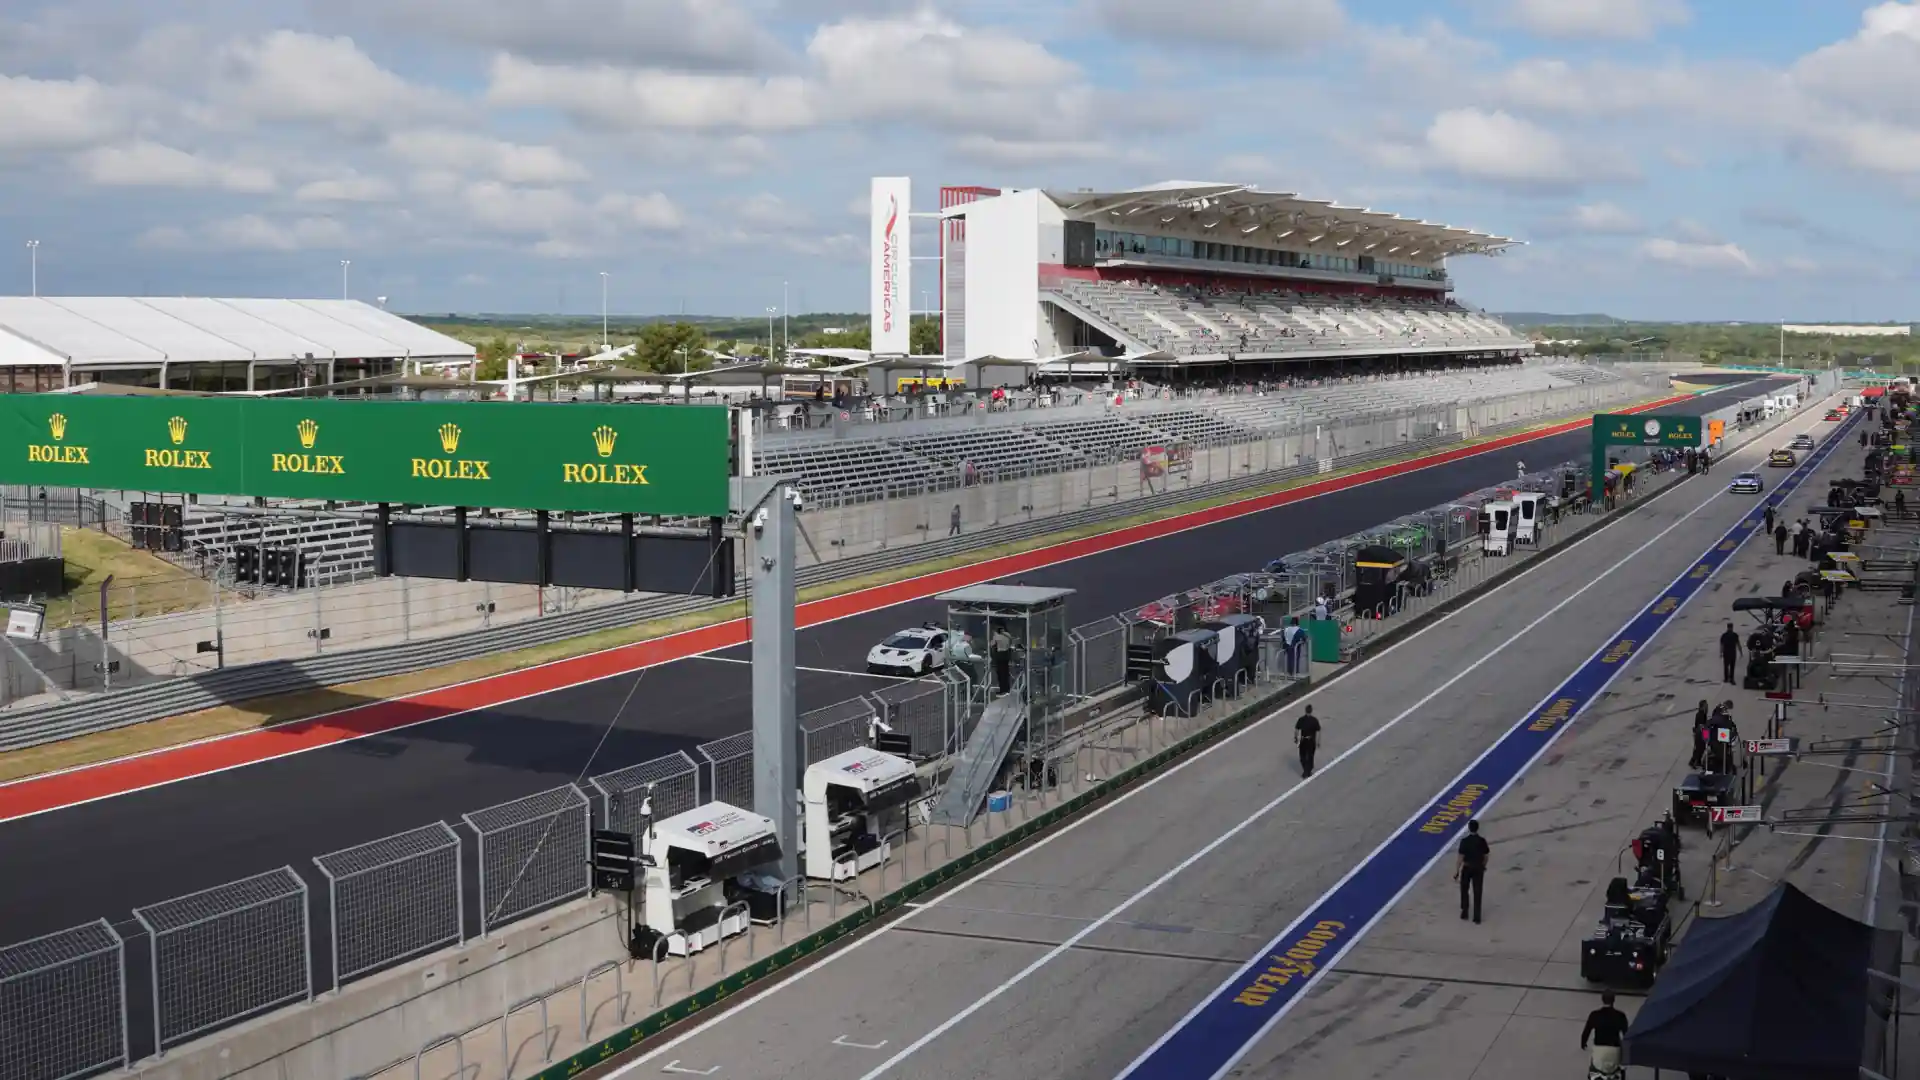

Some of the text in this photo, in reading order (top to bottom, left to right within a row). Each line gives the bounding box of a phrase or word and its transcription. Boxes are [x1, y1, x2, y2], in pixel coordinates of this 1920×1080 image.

[884, 242, 892, 332] AMERICAS
[28, 444, 90, 464] ROLEX
[144, 449, 212, 469] ROLEX
[271, 454, 346, 475] ROLEX
[411, 459, 491, 480] ROLEX
[562, 463, 650, 485] ROLEX
[1748, 740, 1756, 753] 8
[924, 798, 938, 812] 30
[1713, 808, 1722, 822] 7
[1233, 920, 1346, 1007] GOODYEAR
